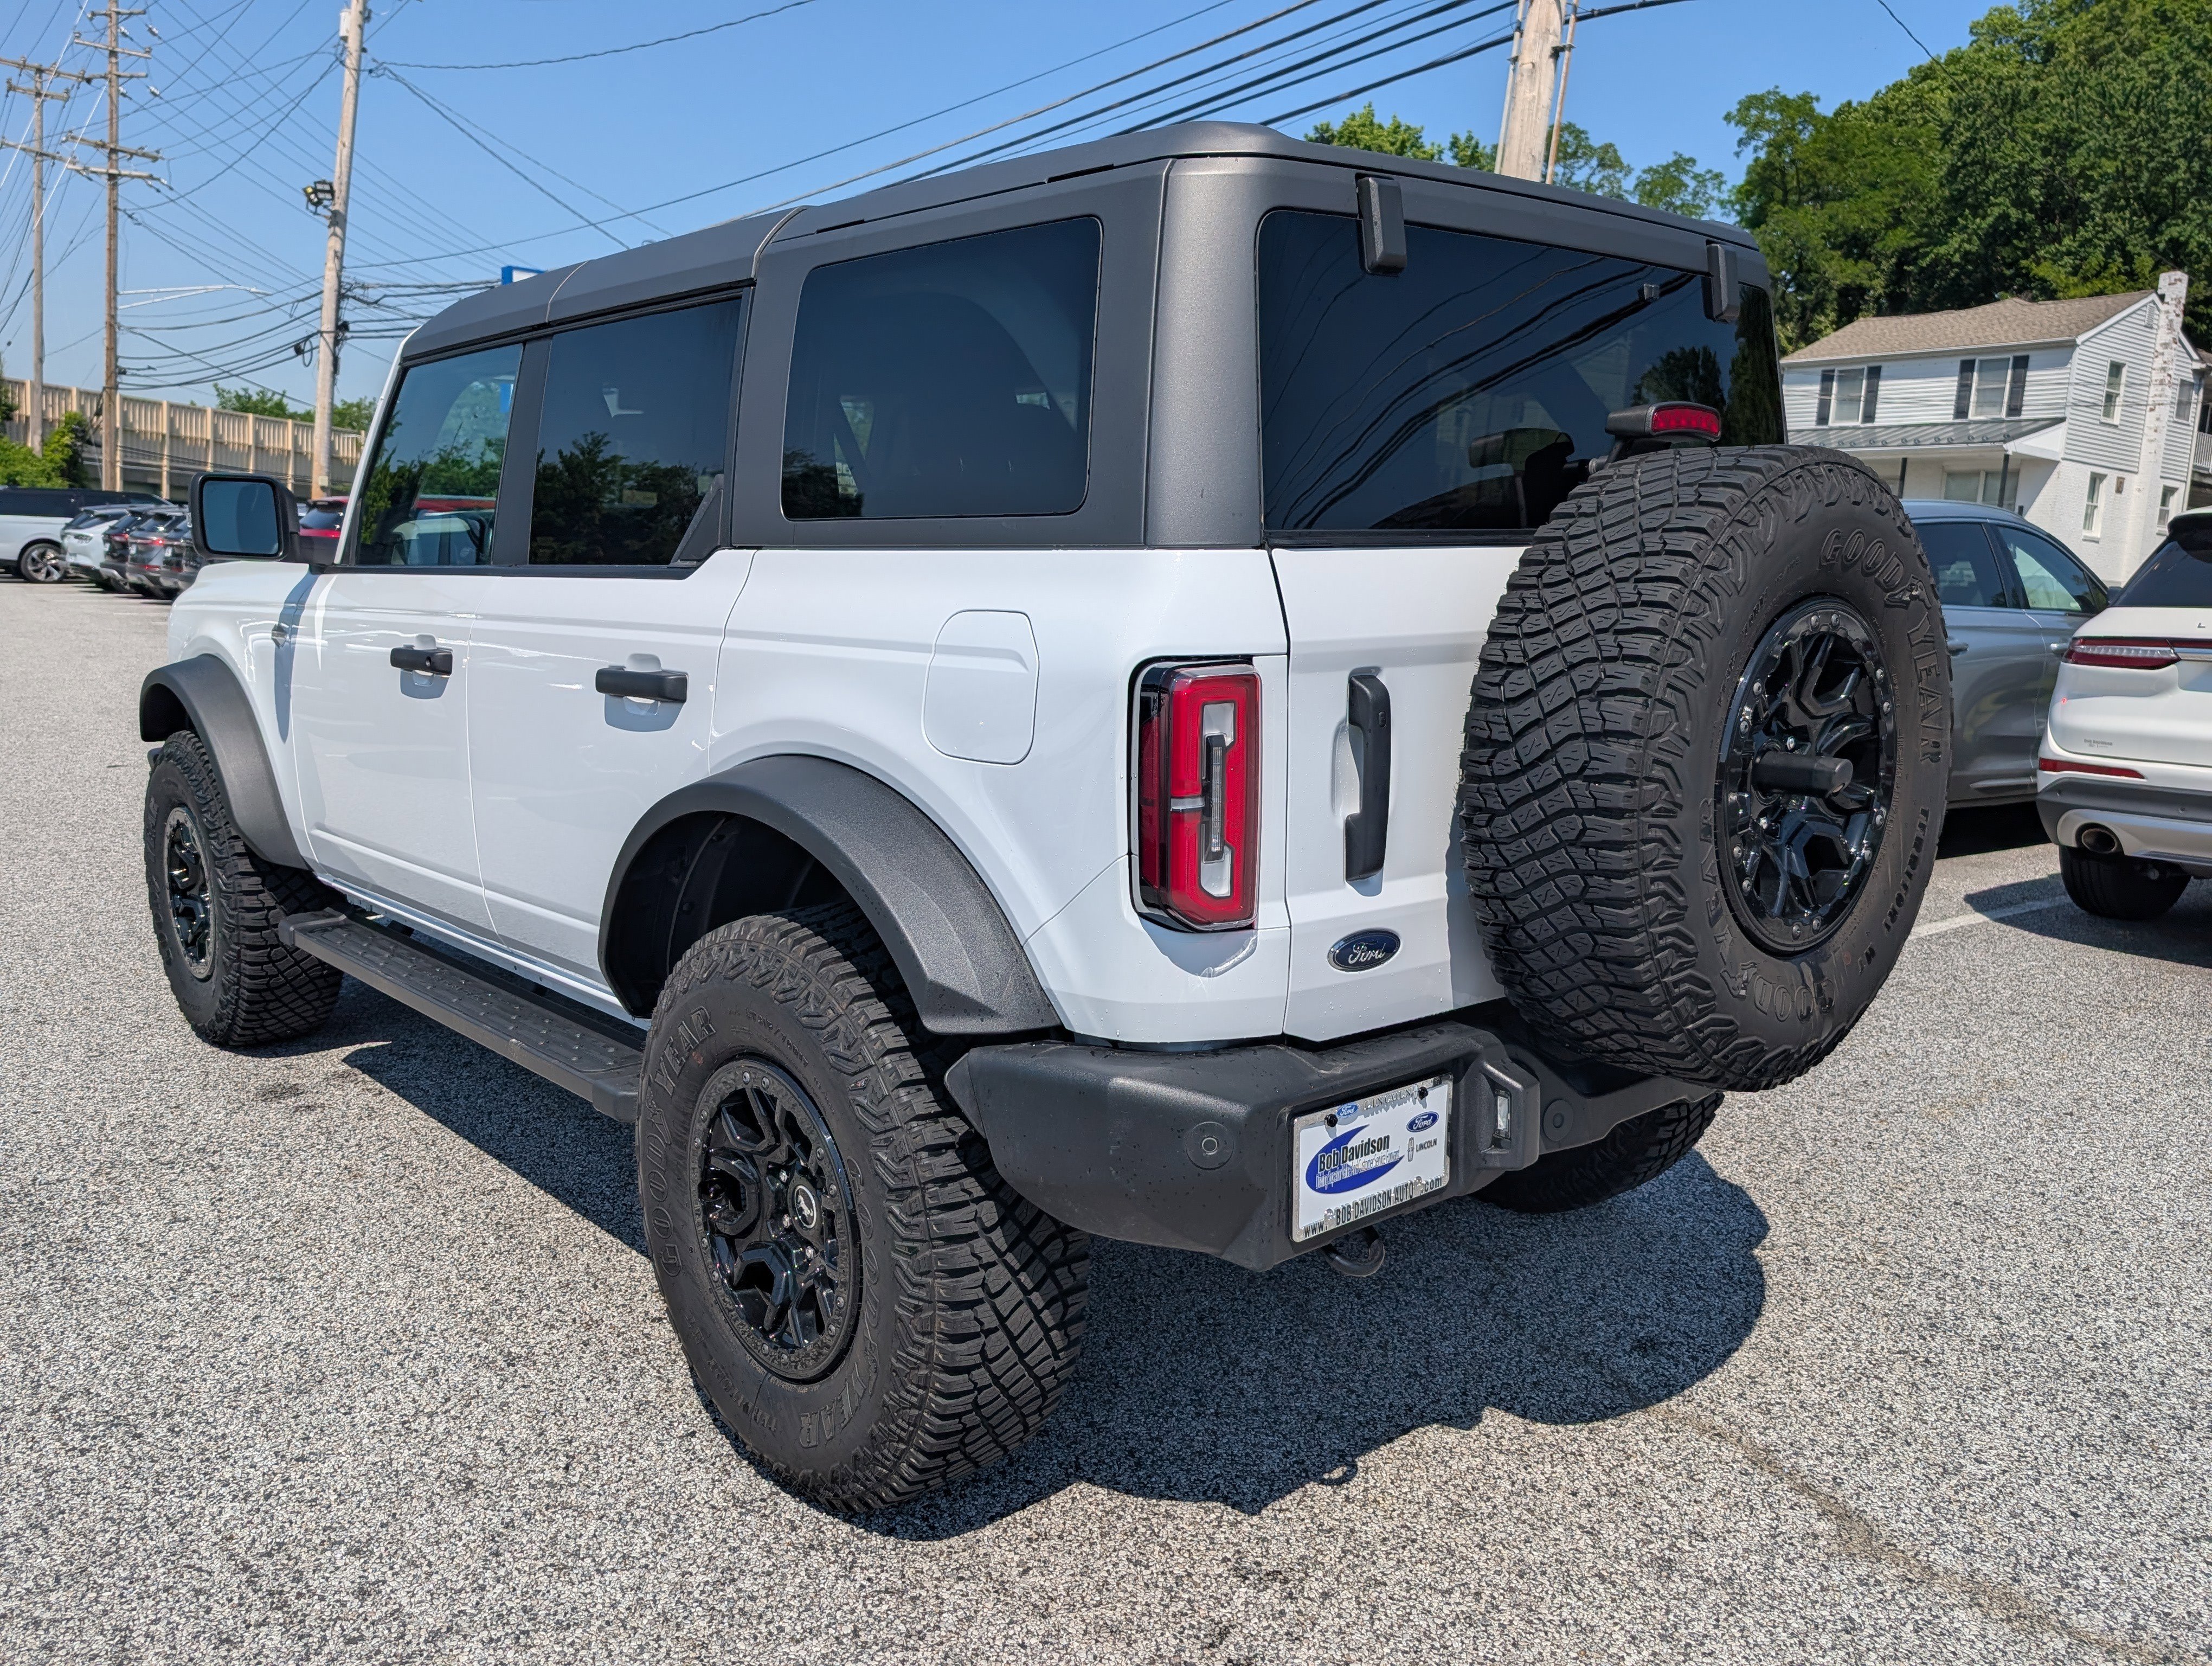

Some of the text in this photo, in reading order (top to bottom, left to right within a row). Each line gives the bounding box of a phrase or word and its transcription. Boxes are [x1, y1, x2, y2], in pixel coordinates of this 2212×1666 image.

[1348, 939, 1387, 964] Ford
[1340, 1088, 1412, 1116] Ford LINCOLN
[1413, 1115, 1432, 1130] Ford
[1318, 1135, 1390, 1172] Bob Davidson
[1416, 1138, 1437, 1152] LINCOLN
[1374, 1153, 1386, 1167] Service
[1336, 1204, 1352, 1226] BOB
[1354, 1191, 1392, 1222] DAVIDSON
[1394, 1181, 1414, 1204] AUTO
